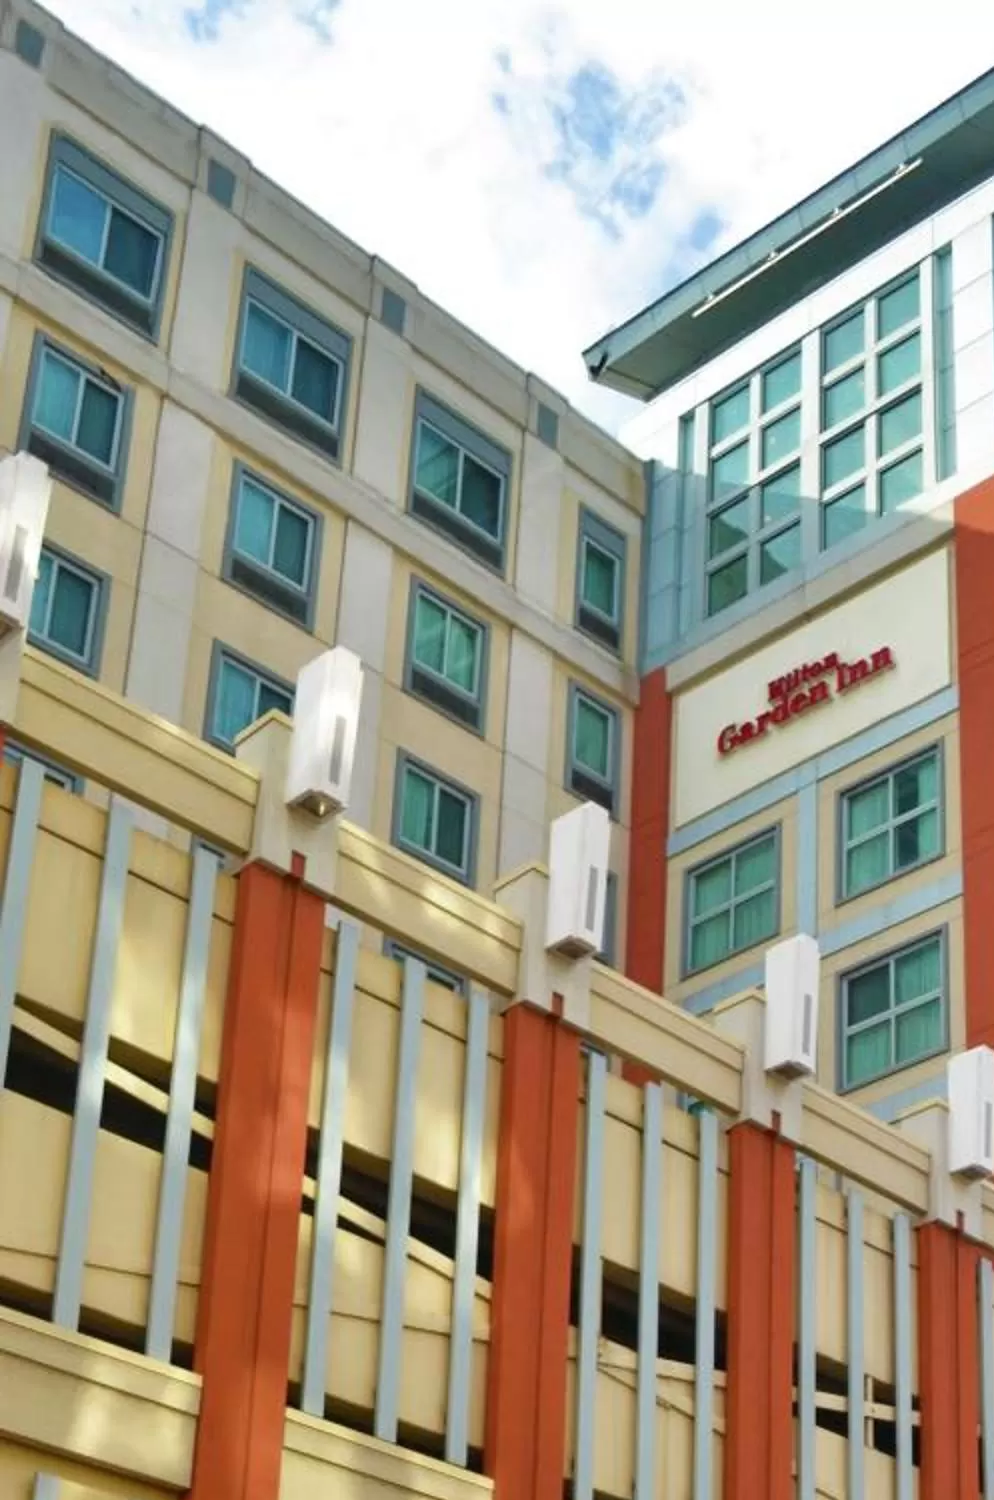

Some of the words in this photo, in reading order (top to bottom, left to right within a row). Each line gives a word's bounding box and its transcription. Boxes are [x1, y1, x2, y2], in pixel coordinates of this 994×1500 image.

[717, 680, 831, 757] Garden
[834, 646, 895, 694] Inn
[766, 651, 841, 702] Hilton
